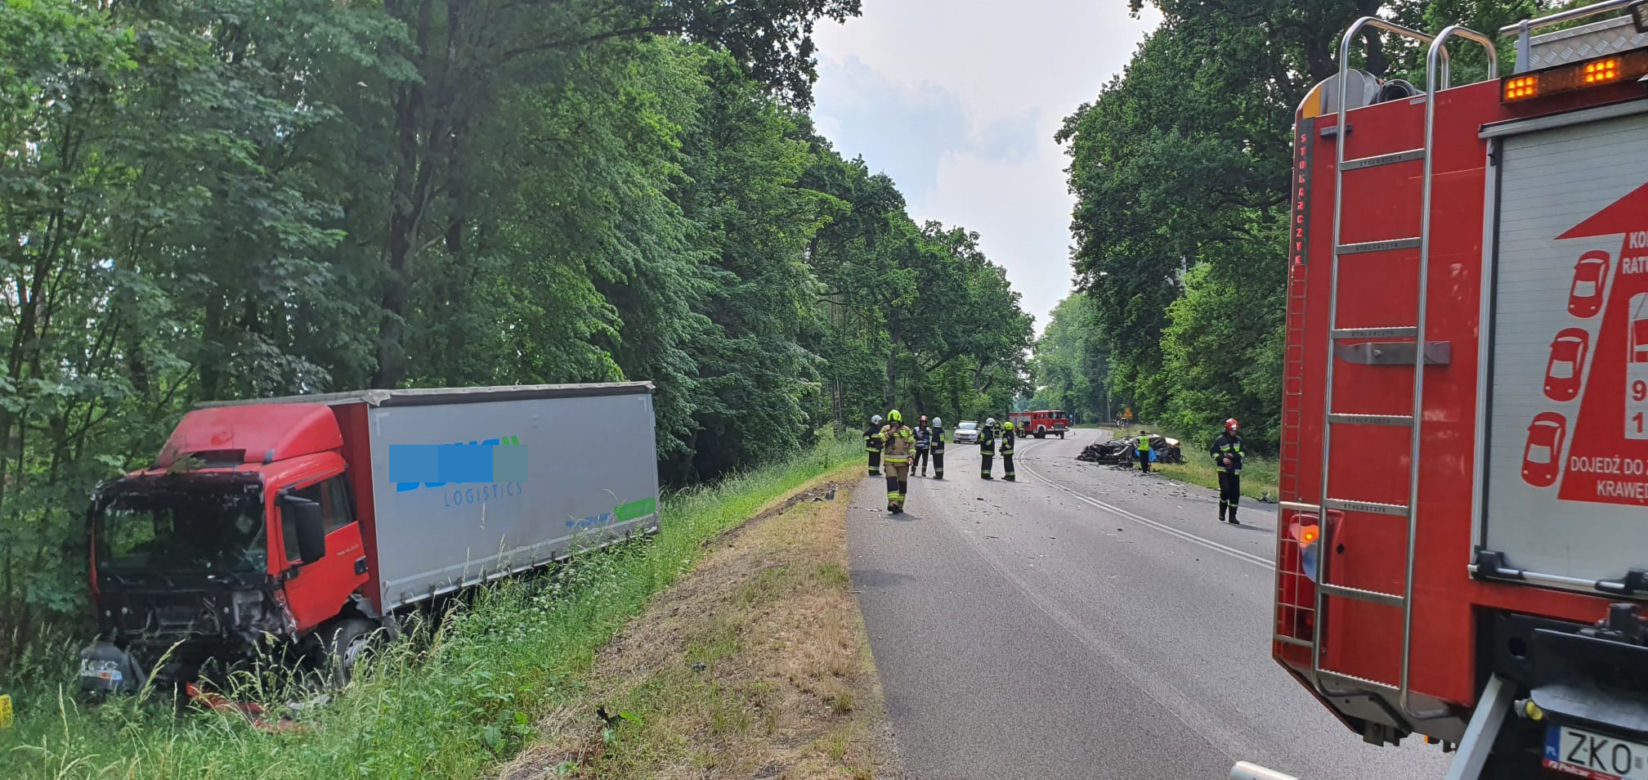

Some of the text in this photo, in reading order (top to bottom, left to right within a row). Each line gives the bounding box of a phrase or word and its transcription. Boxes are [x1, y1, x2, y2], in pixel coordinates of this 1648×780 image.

[1630, 231, 1648, 249] KO
[1571, 453, 1621, 475] DOJEDŹ
[1624, 457, 1644, 476] DO
[444, 481, 523, 508] LOGISTICS
[1596, 480, 1648, 503] KRAWĘ
[1567, 730, 1632, 775] ZKO
